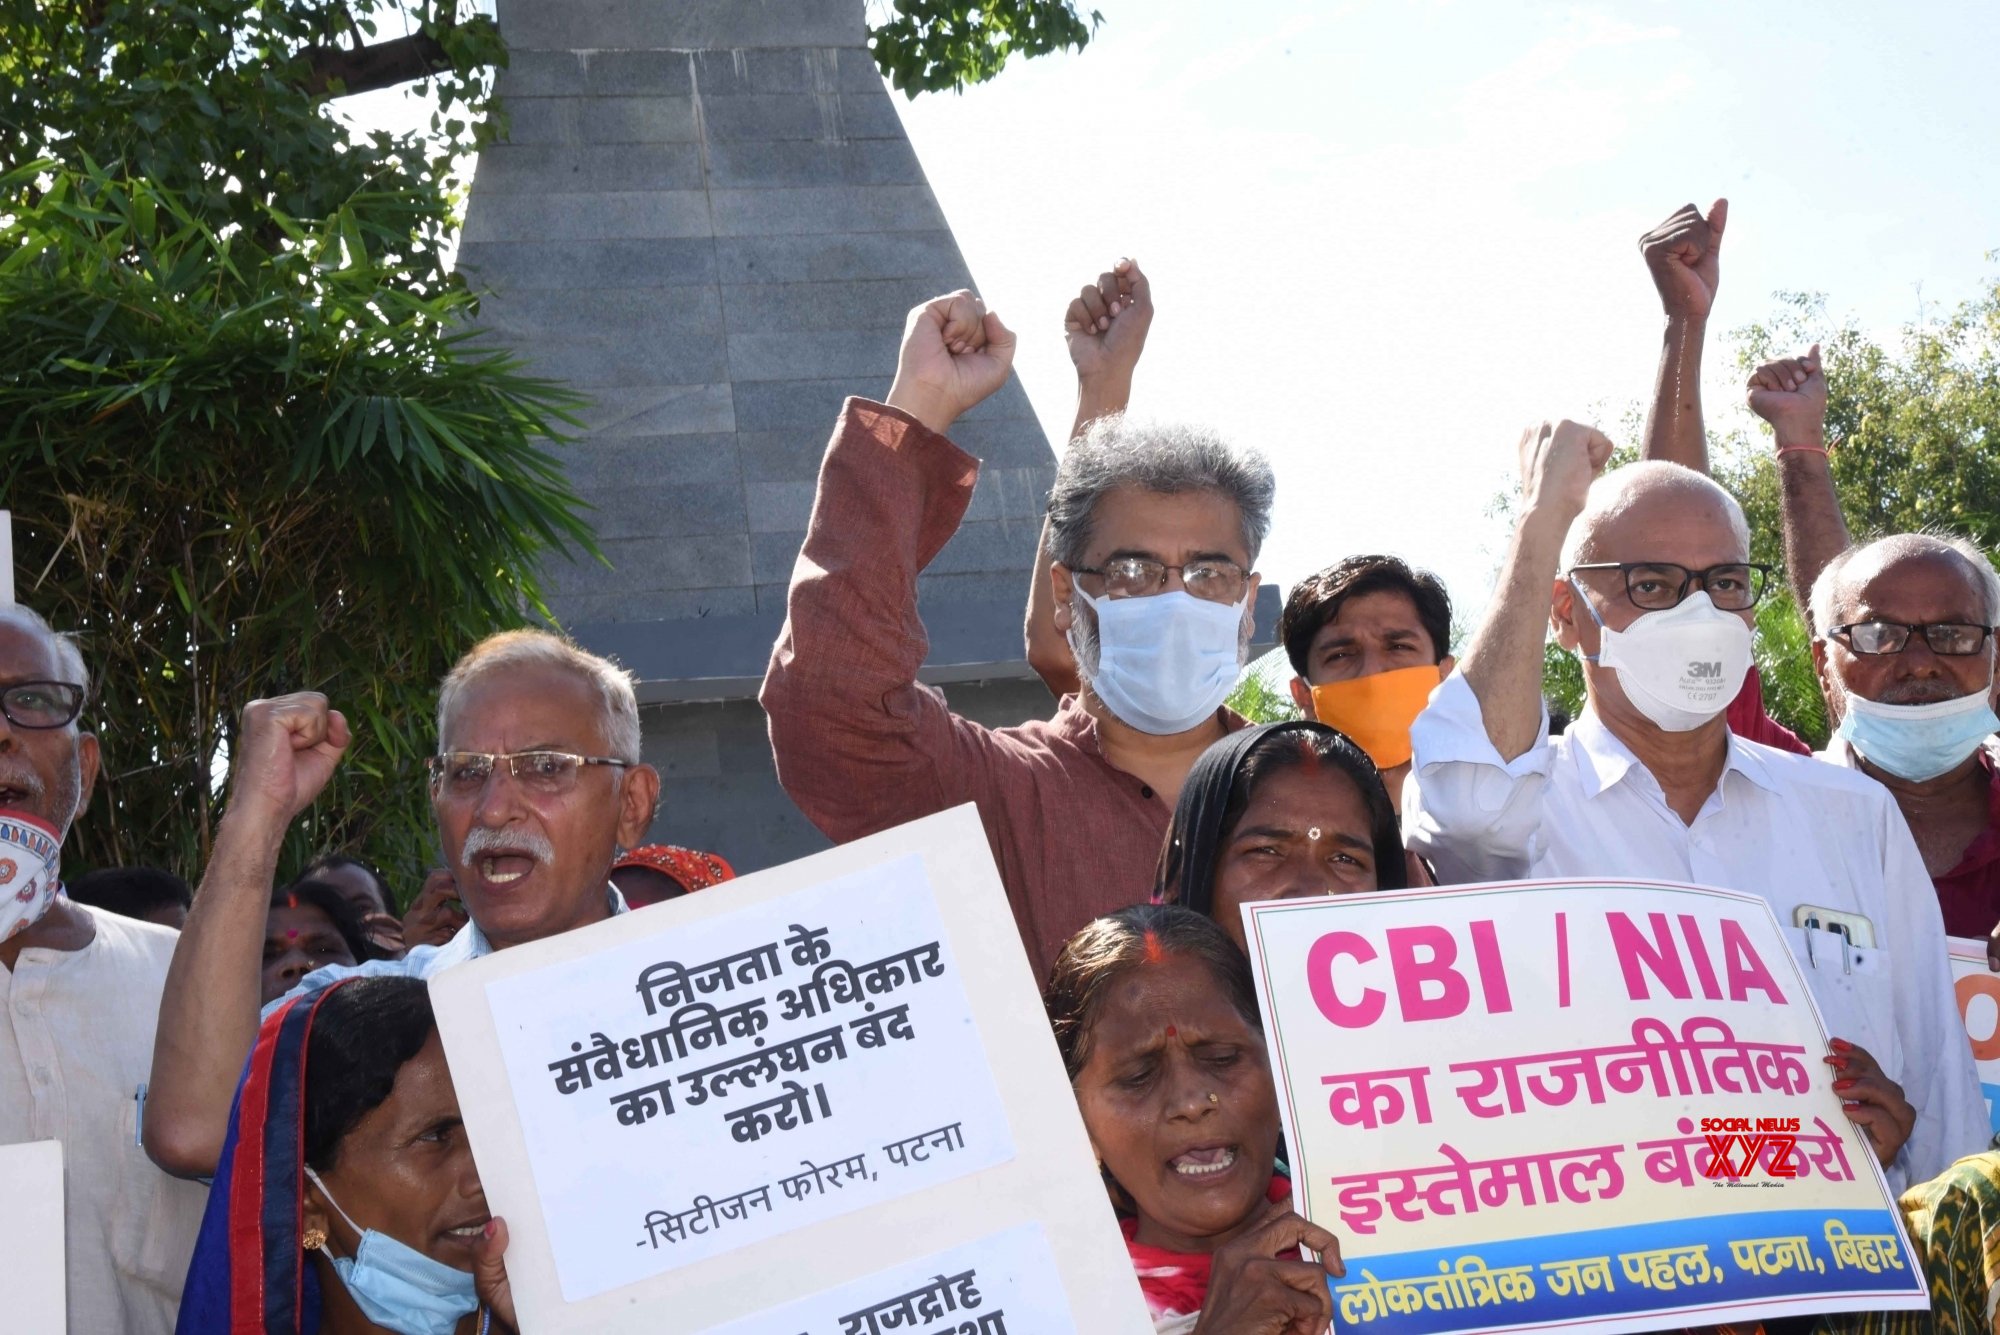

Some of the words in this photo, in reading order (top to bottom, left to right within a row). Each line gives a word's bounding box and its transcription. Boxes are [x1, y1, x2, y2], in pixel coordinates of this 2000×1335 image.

[1687, 661, 1722, 678] 3M
[548, 997, 768, 1095] संवैधानिक
[776, 940, 945, 1021] अधिकार
[636, 942, 783, 1016] निजता
[784, 923, 832, 968] के
[1306, 919, 1513, 1029] CBI
[1555, 912, 1571, 1008] /
[1605, 911, 1789, 1005] NIA
[610, 1079, 676, 1127] का
[678, 1025, 847, 1106] उल्लंघन
[849, 1001, 915, 1050] बंद
[724, 1080, 833, 1144] करो।
[1321, 1066, 1433, 1131] का
[1449, 1017, 1811, 1119] राजनीतिक
[636, 1184, 773, 1250] -सिटीजन
[778, 1153, 878, 1202] फोरम,
[882, 1121, 965, 1167] पटना
[1331, 1143, 1625, 1235] इस्तेमाल
[838, 1268, 982, 1335] राजद्रोह
[1335, 1255, 1536, 1325] लोकतांत्रिक
[1540, 1256, 1615, 1296] जन
[1618, 1244, 1724, 1290] पहल,
[1728, 1236, 1825, 1275] पटना,
[1824, 1219, 1904, 1273] बिहार
